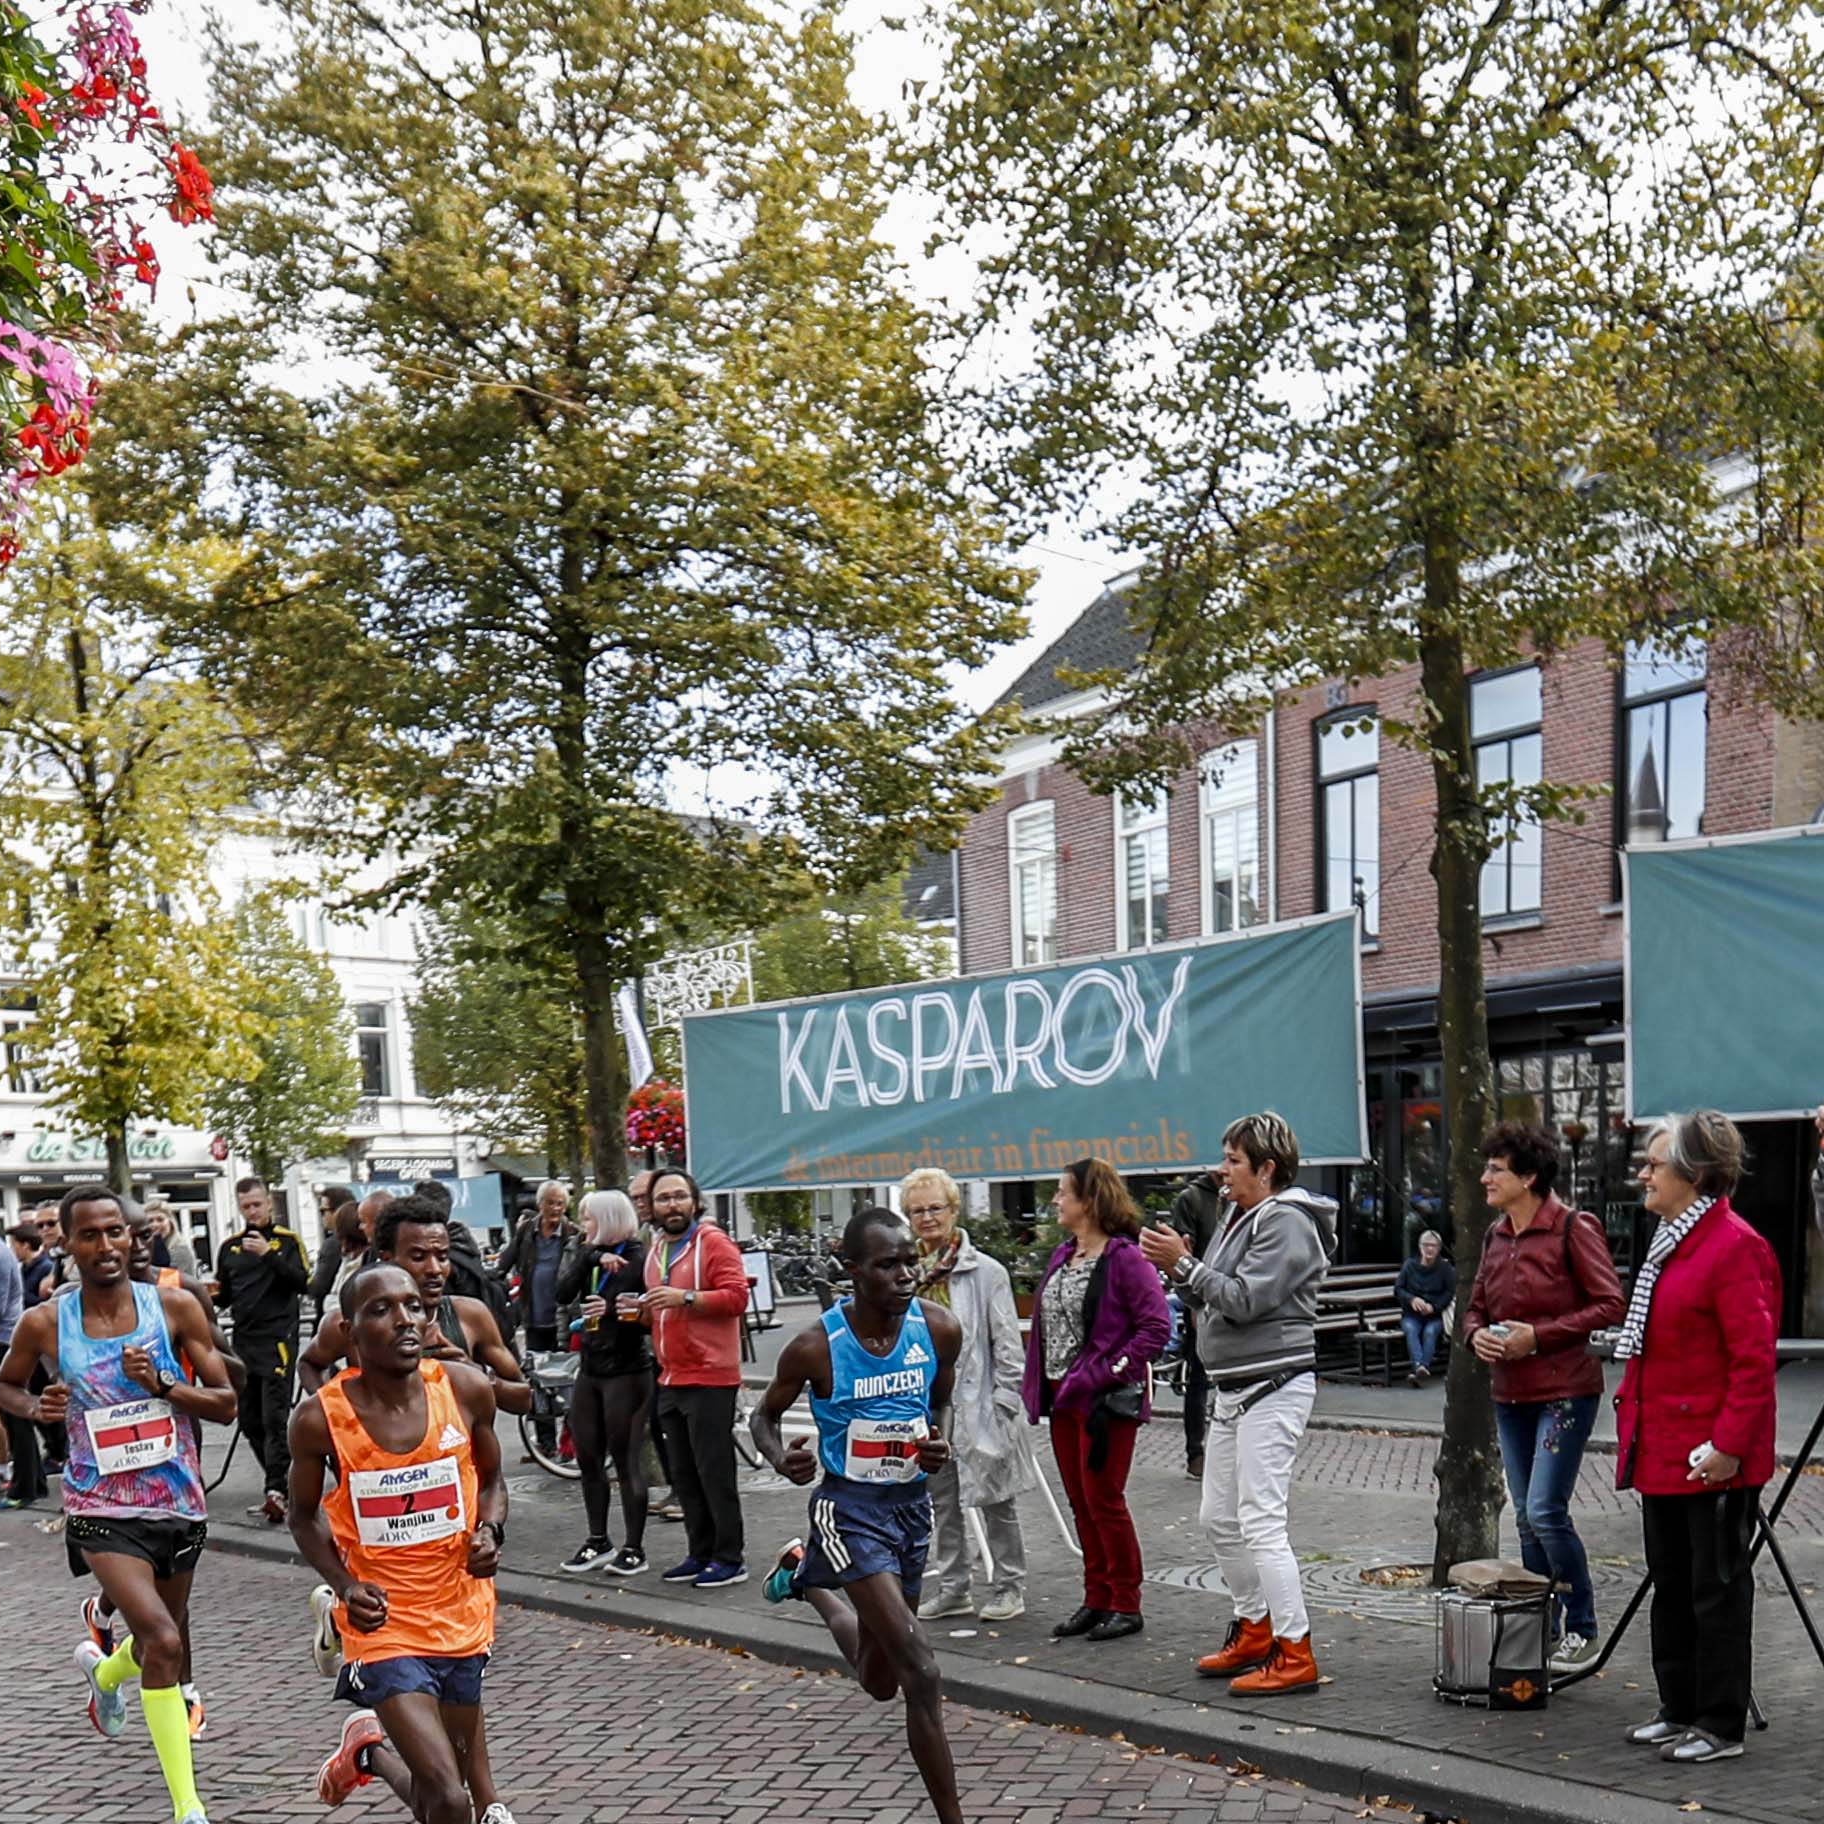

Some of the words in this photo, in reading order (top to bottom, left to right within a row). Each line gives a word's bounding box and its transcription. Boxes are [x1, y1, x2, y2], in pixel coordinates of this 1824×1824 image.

[778, 956, 1193, 1113] KASPAROV
[783, 1146, 812, 1181] de
[817, 1135, 983, 1179] intermediair
[991, 1131, 1025, 1172] in
[1031, 1119, 1192, 1171] financials
[853, 1368, 925, 1399] RUNCZECH
[129, 1425, 141, 1441] 1
[379, 1467, 429, 1487] AMGEN
[401, 1493, 417, 1515] 2
[387, 1513, 436, 1530] Wanjiku
